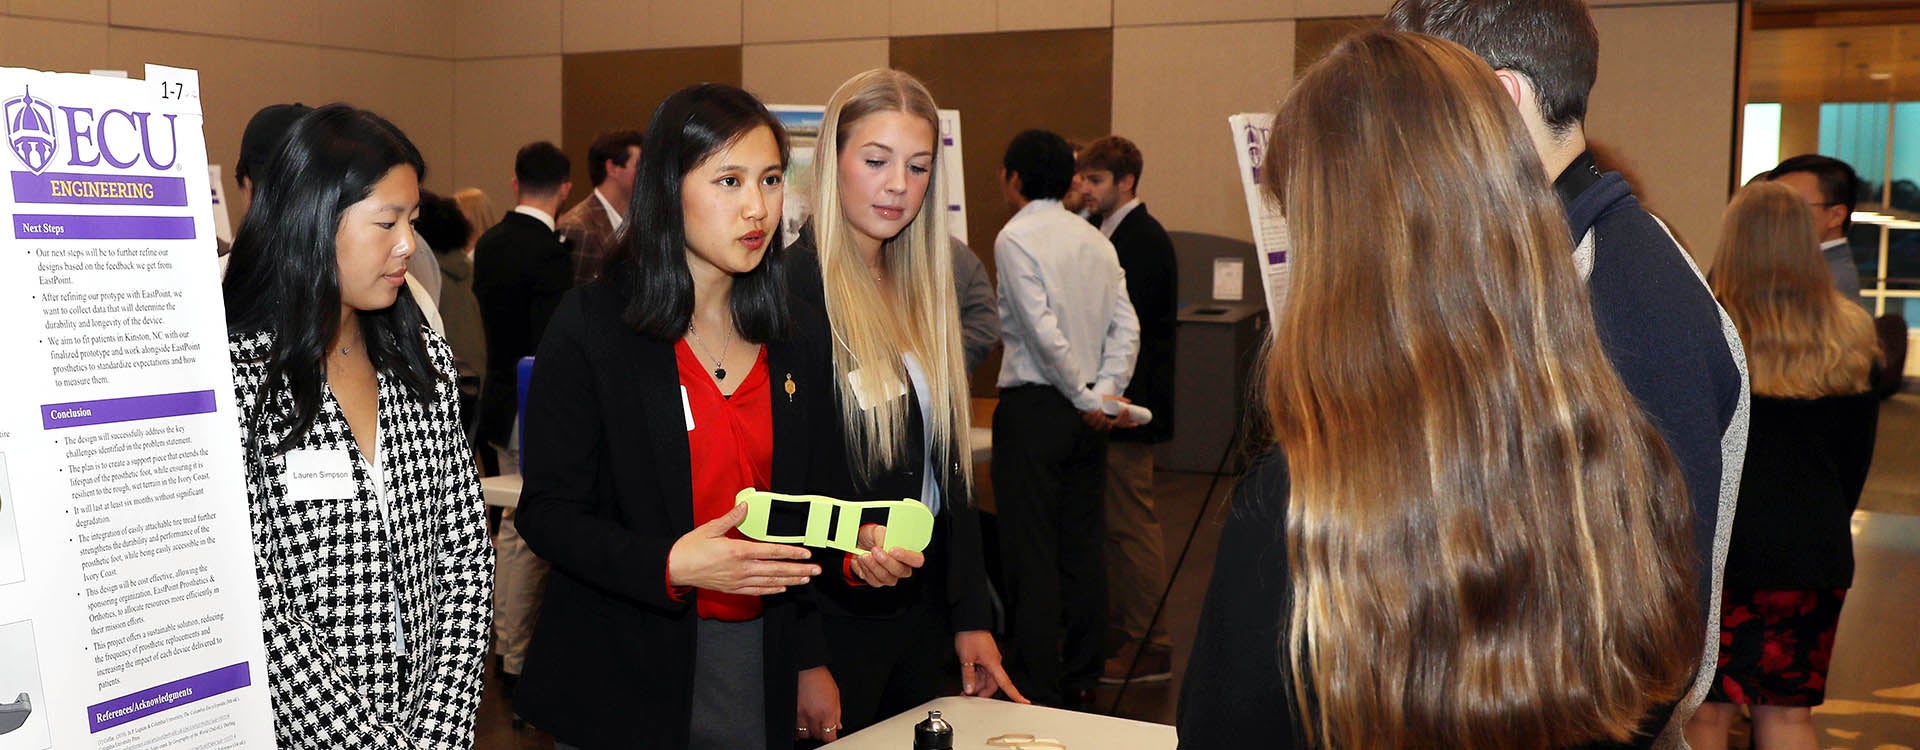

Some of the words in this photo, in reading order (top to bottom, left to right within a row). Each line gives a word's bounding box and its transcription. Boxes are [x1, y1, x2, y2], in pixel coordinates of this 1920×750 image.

[161, 81, 183, 100] 1-7
[58, 106, 177, 170] ECU
[50, 180, 154, 200] ENGINEERING
[23, 223, 41, 233] Next
[43, 223, 64, 236] Steps
[36, 248, 50, 257] Our
[67, 250, 84, 259] steps
[85, 248, 98, 257] will
[117, 248, 138, 256] further
[139, 248, 157, 256] refine
[38, 262, 63, 273] designs
[64, 262, 84, 271] based
[94, 261, 104, 270] the
[106, 261, 134, 270] feedback
[147, 263, 157, 272] get
[157, 261, 172, 269] from
[42, 293, 59, 302] After
[60, 292, 87, 303] refining
[126, 290, 141, 299] with
[69, 305, 91, 314] collect
[92, 305, 106, 313] data
[107, 304, 120, 313] that
[121, 303, 134, 312] will
[135, 303, 165, 312] determine
[166, 302, 176, 310] the
[45, 320, 76, 330] durability
[78, 319, 91, 328] and
[91, 319, 121, 329] longevity
[130, 317, 141, 325] the
[48, 337, 59, 346] We
[61, 337, 74, 345] aim
[91, 336, 116, 345] patients
[152, 331, 162, 340] NC
[164, 330, 179, 339] with
[80, 350, 110, 360] prototype
[111, 347, 124, 356] and
[124, 346, 141, 355] work
[142, 344, 170, 355] alongside
[172, 343, 200, 352] EastPoint
[53, 363, 88, 375] prosthetics
[97, 360, 132, 370] standardize
[133, 359, 170, 369] expectations
[171, 356, 183, 365] and
[183, 356, 196, 364] how
[64, 378, 90, 386] measure
[51, 408, 92, 420] Conclusion
[64, 437, 76, 445] The
[77, 436, 97, 444] design
[98, 432, 110, 441] will
[111, 429, 144, 440] successfully
[145, 427, 165, 436] address
[166, 426, 175, 434] the
[175, 425, 185, 433] key
[66, 449, 97, 458] challenges
[98, 443, 125, 454] identified
[132, 442, 142, 450] the
[143, 440, 165, 450] problem
[68, 465, 80, 473] The
[81, 464, 94, 474] plan
[108, 460, 125, 468] create
[131, 457, 152, 466] support
[167, 452, 178, 460] that
[178, 449, 199, 459] extends
[199, 448, 209, 456] the
[101, 474, 110, 482] the
[111, 471, 138, 482] prosthetic
[153, 466, 169, 474] while
[293, 471, 318, 480] Lauren
[319, 471, 348, 480] Simpson
[72, 490, 95, 499] resilient
[143, 479, 161, 488] terrain
[168, 477, 177, 485] the
[178, 476, 192, 484] Ivory
[73, 506, 80, 515] It
[80, 504, 92, 513] will
[110, 501, 123, 509] least
[133, 496, 154, 505] months
[154, 493, 175, 501] without
[176, 488, 204, 500] significant
[78, 534, 90, 543] The
[91, 530, 121, 541] integration
[128, 524, 144, 534] easily
[145, 520, 172, 531] attachable
[198, 513, 216, 521] further
[112, 541, 122, 549] the
[122, 537, 148, 548] durability
[149, 533, 159, 543] and
[160, 530, 193, 542] performance
[200, 525, 210, 533] the
[82, 558, 109, 570] prosthetic
[123, 550, 139, 559] while
[139, 549, 155, 557] being
[156, 544, 171, 554] easily
[206, 536, 216, 544] the
[83, 573, 99, 582] Ivory
[86, 588, 99, 597] This
[100, 584, 118, 594] design
[119, 580, 130, 589] will
[137, 577, 149, 586] cost
[175, 568, 199, 577] allowing
[198, 564, 208, 572] the
[88, 598, 118, 611] sponsoring
[153, 583, 179, 594] EastPoint
[179, 577, 209, 589] Prosthetics
[209, 575, 215, 583] &
[124, 604, 144, 614] allocate
[145, 599, 170, 609] resources
[170, 595, 185, 603] more
[91, 626, 104, 635] their
[105, 622, 126, 632] mission
[93, 641, 106, 651] This
[107, 637, 126, 649] project
[126, 633, 142, 642] offers
[147, 624, 176, 637] sustainable
[201, 613, 224, 622] reducing
[94, 655, 104, 663] the
[105, 649, 131, 661] frequency
[138, 640, 164, 654] prosthetic
[166, 631, 200, 645] replacements
[201, 626, 211, 636] and
[125, 660, 134, 668] the
[173, 645, 190, 655] device
[191, 638, 216, 650] delivered
[96, 687, 192, 723] References/Acknowledgments
